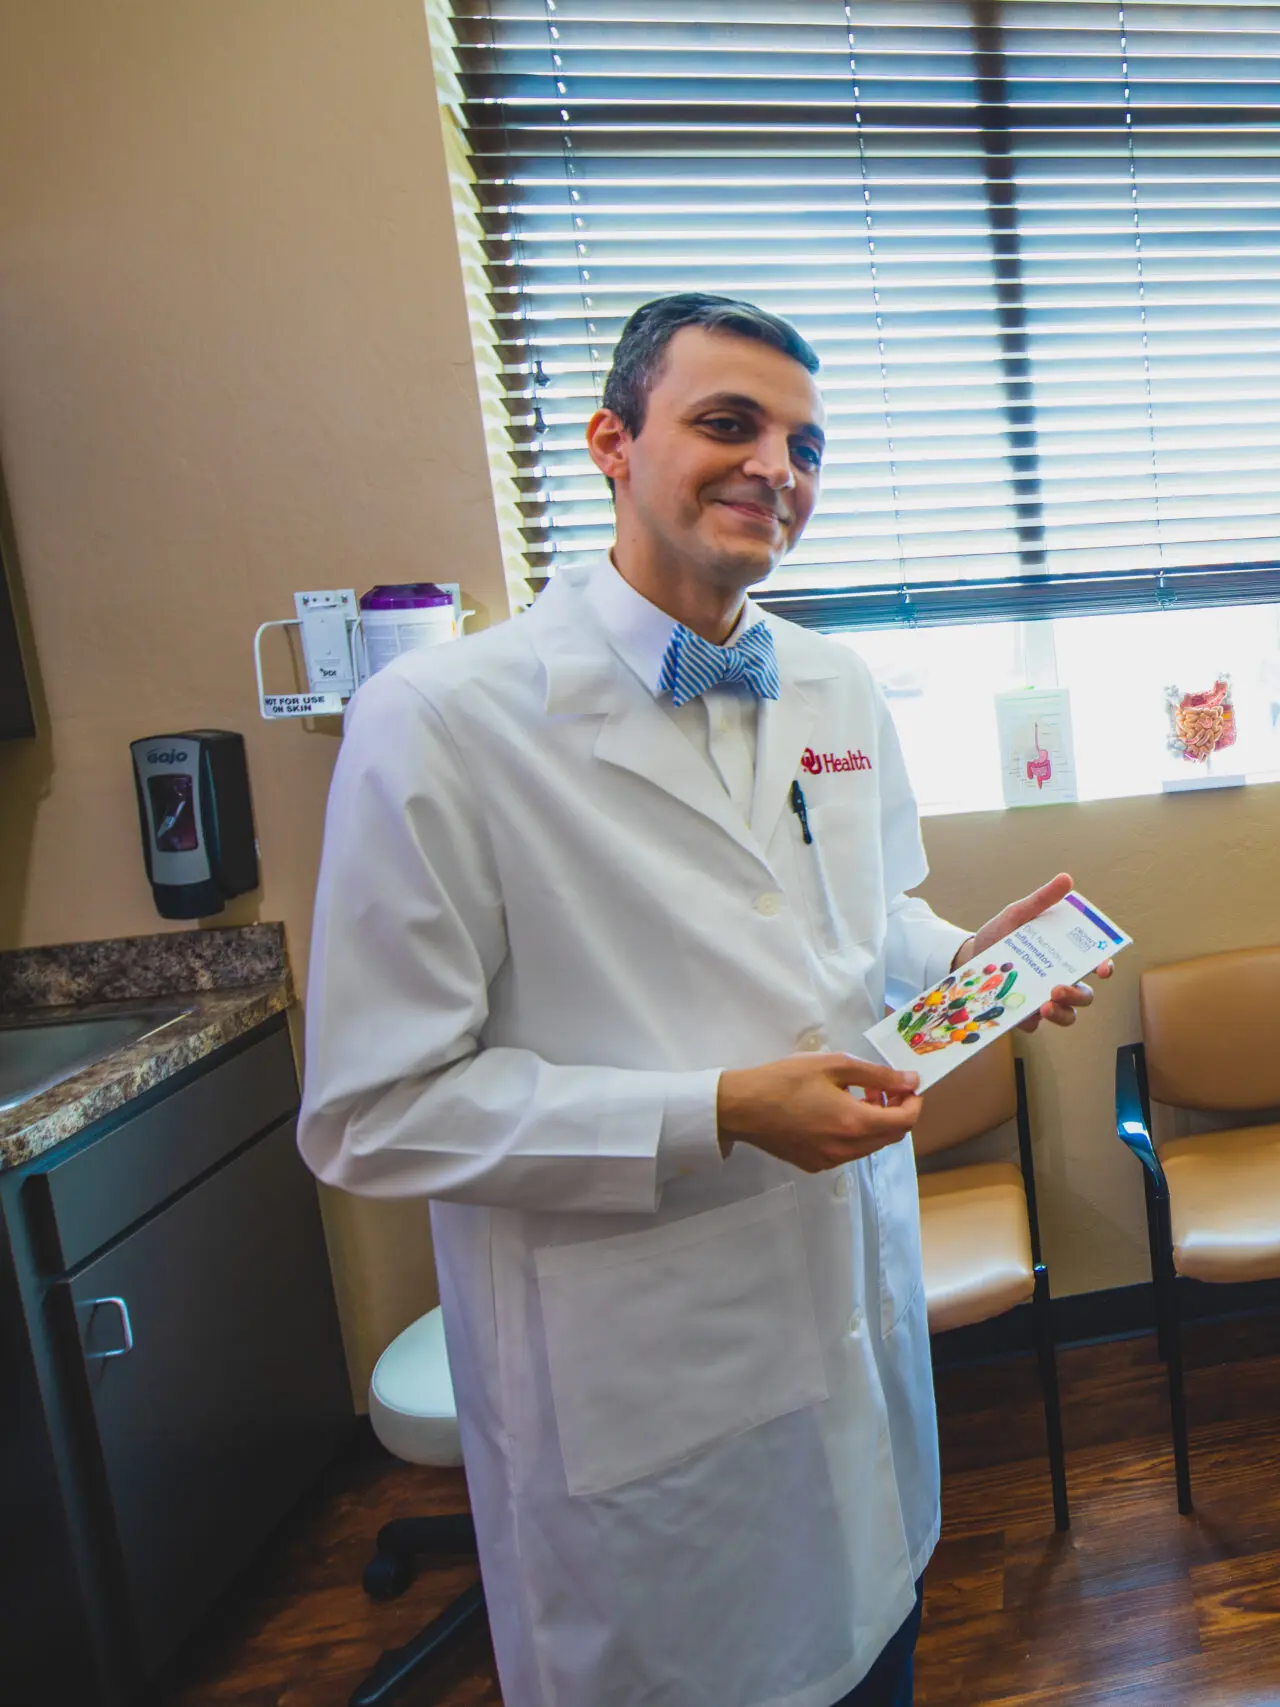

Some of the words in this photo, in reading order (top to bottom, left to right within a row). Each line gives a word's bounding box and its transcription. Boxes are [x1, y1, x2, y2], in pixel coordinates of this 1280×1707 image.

[303, 696, 325, 704] USE
[287, 705, 312, 713] SKIN
[822, 748, 872, 773] Health
[1004, 937, 1025, 956] Bowel
[1022, 953, 1047, 978] Disease
